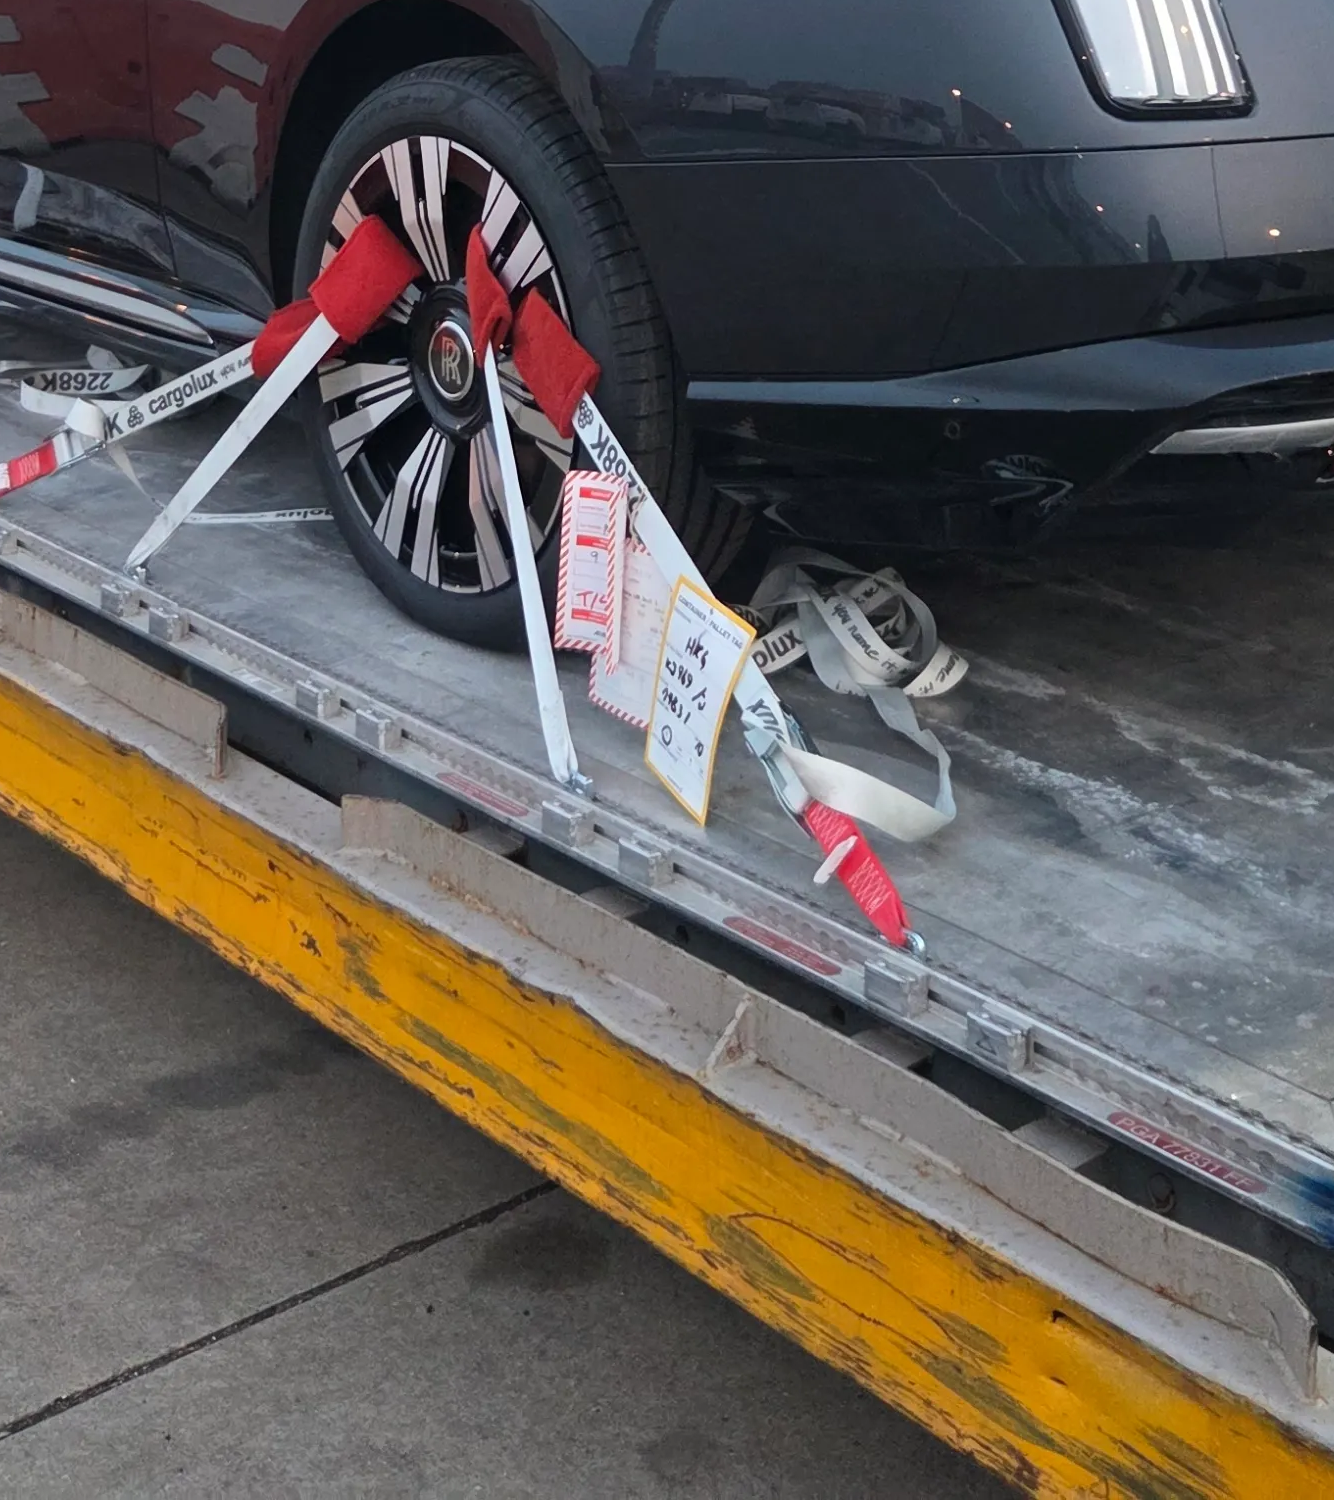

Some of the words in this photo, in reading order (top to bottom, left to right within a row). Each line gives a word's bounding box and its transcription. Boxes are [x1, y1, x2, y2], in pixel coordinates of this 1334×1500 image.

[40, 371, 114, 392] 2268K
[148, 370, 218, 415] cargolux
[709, 621, 732, 640] PALLET
[732, 637, 744, 650] TAG
[847, 624, 880, 661] name
[1115, 1116, 1160, 1144] PGA
[1163, 1140, 1221, 1173] 77831
[1223, 1169, 1255, 1187] FF
